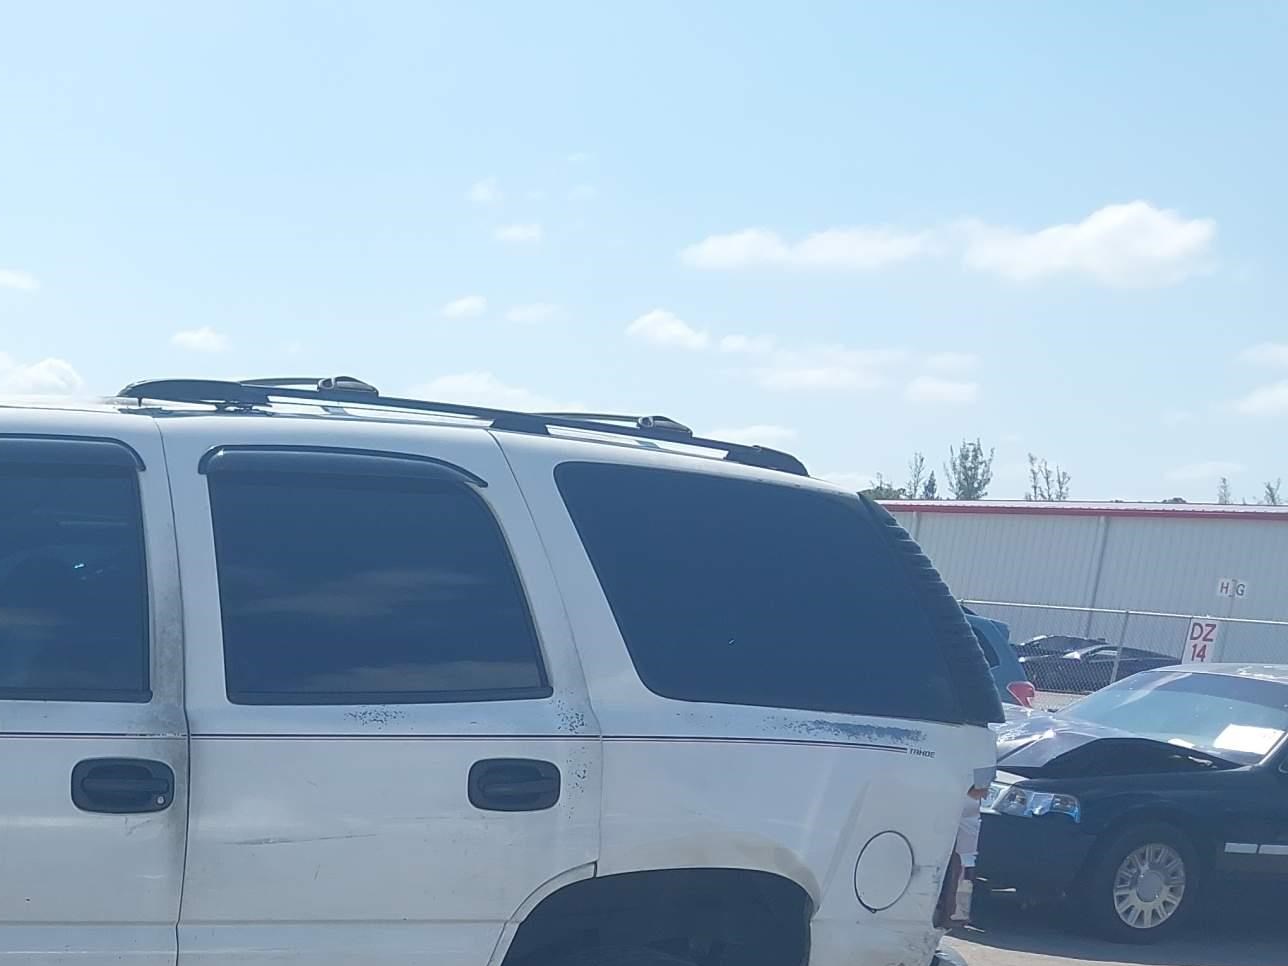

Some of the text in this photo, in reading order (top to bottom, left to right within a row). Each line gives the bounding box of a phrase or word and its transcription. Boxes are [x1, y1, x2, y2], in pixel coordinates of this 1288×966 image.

[1220, 582, 1246, 596] H G
[1190, 623, 1217, 642] DZ
[1191, 644, 1207, 662] 14
